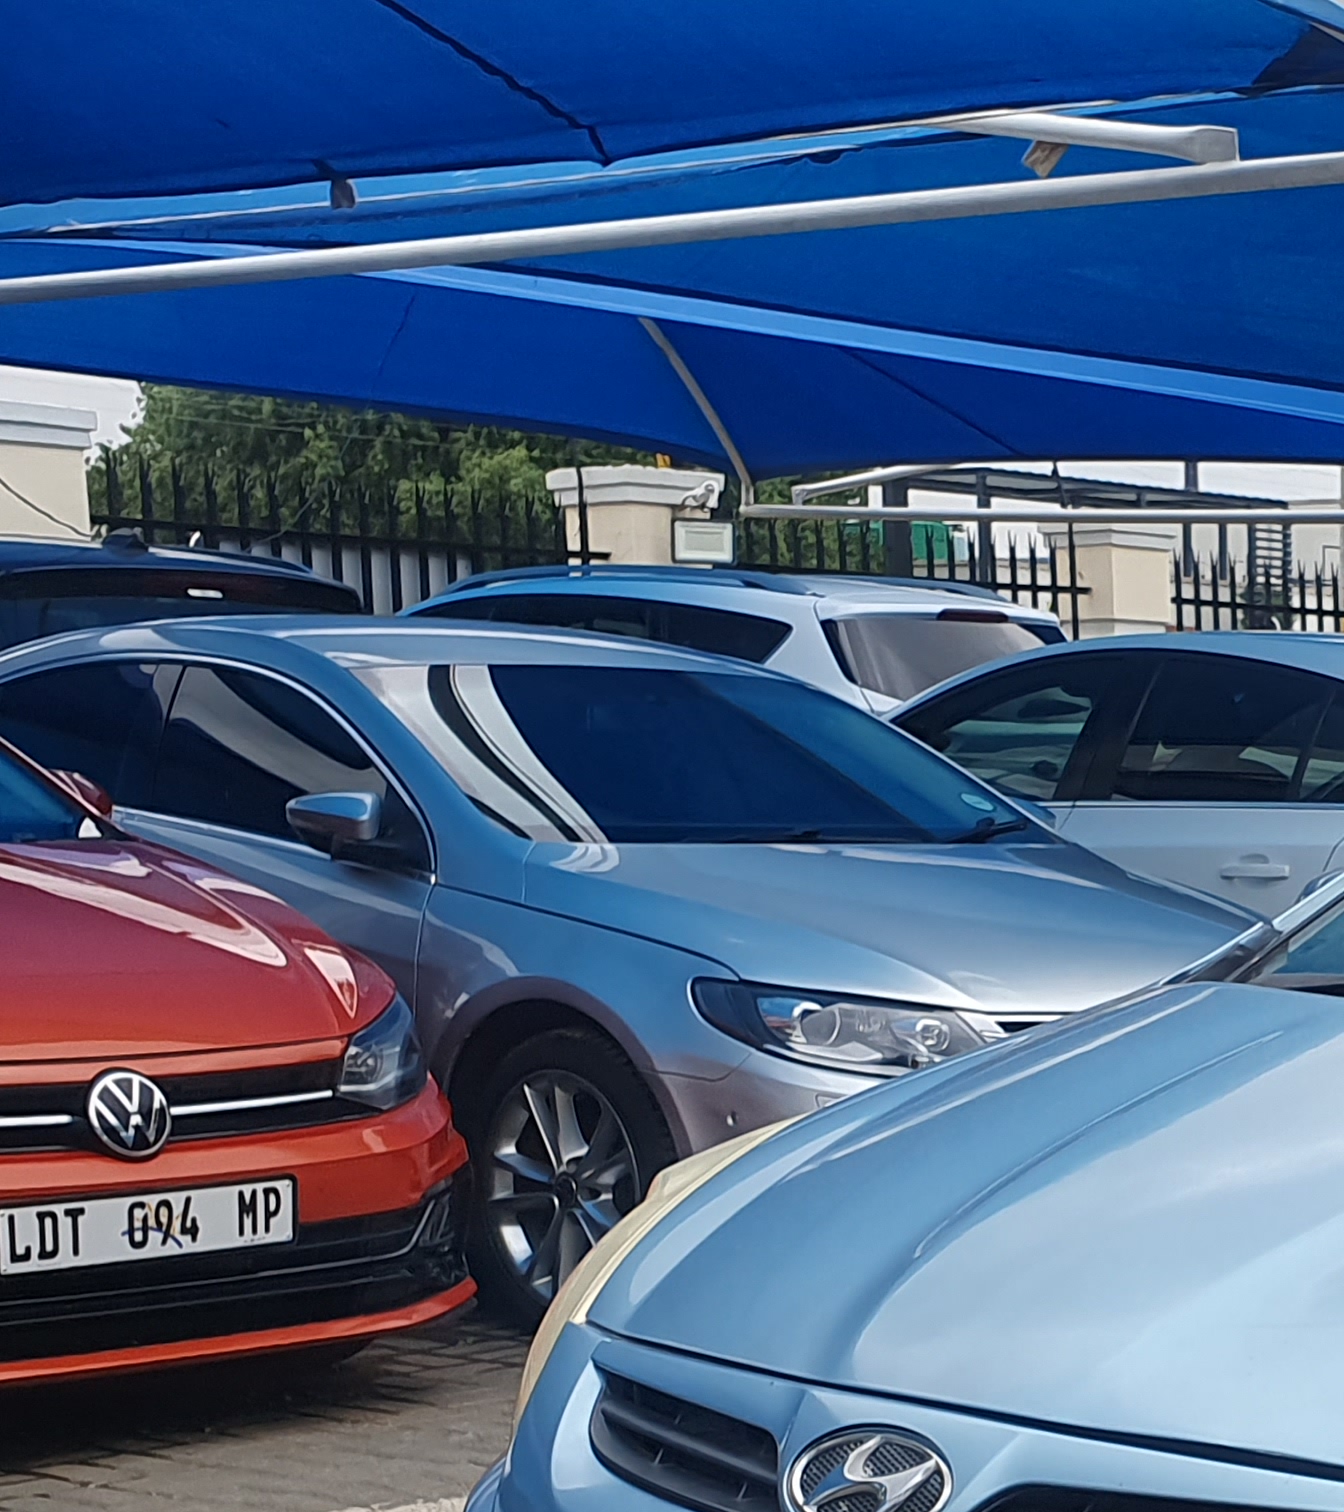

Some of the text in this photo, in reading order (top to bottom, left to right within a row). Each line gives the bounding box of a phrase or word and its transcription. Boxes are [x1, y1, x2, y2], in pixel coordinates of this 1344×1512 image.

[8, 1187, 281, 1264] LDT 094 MP
